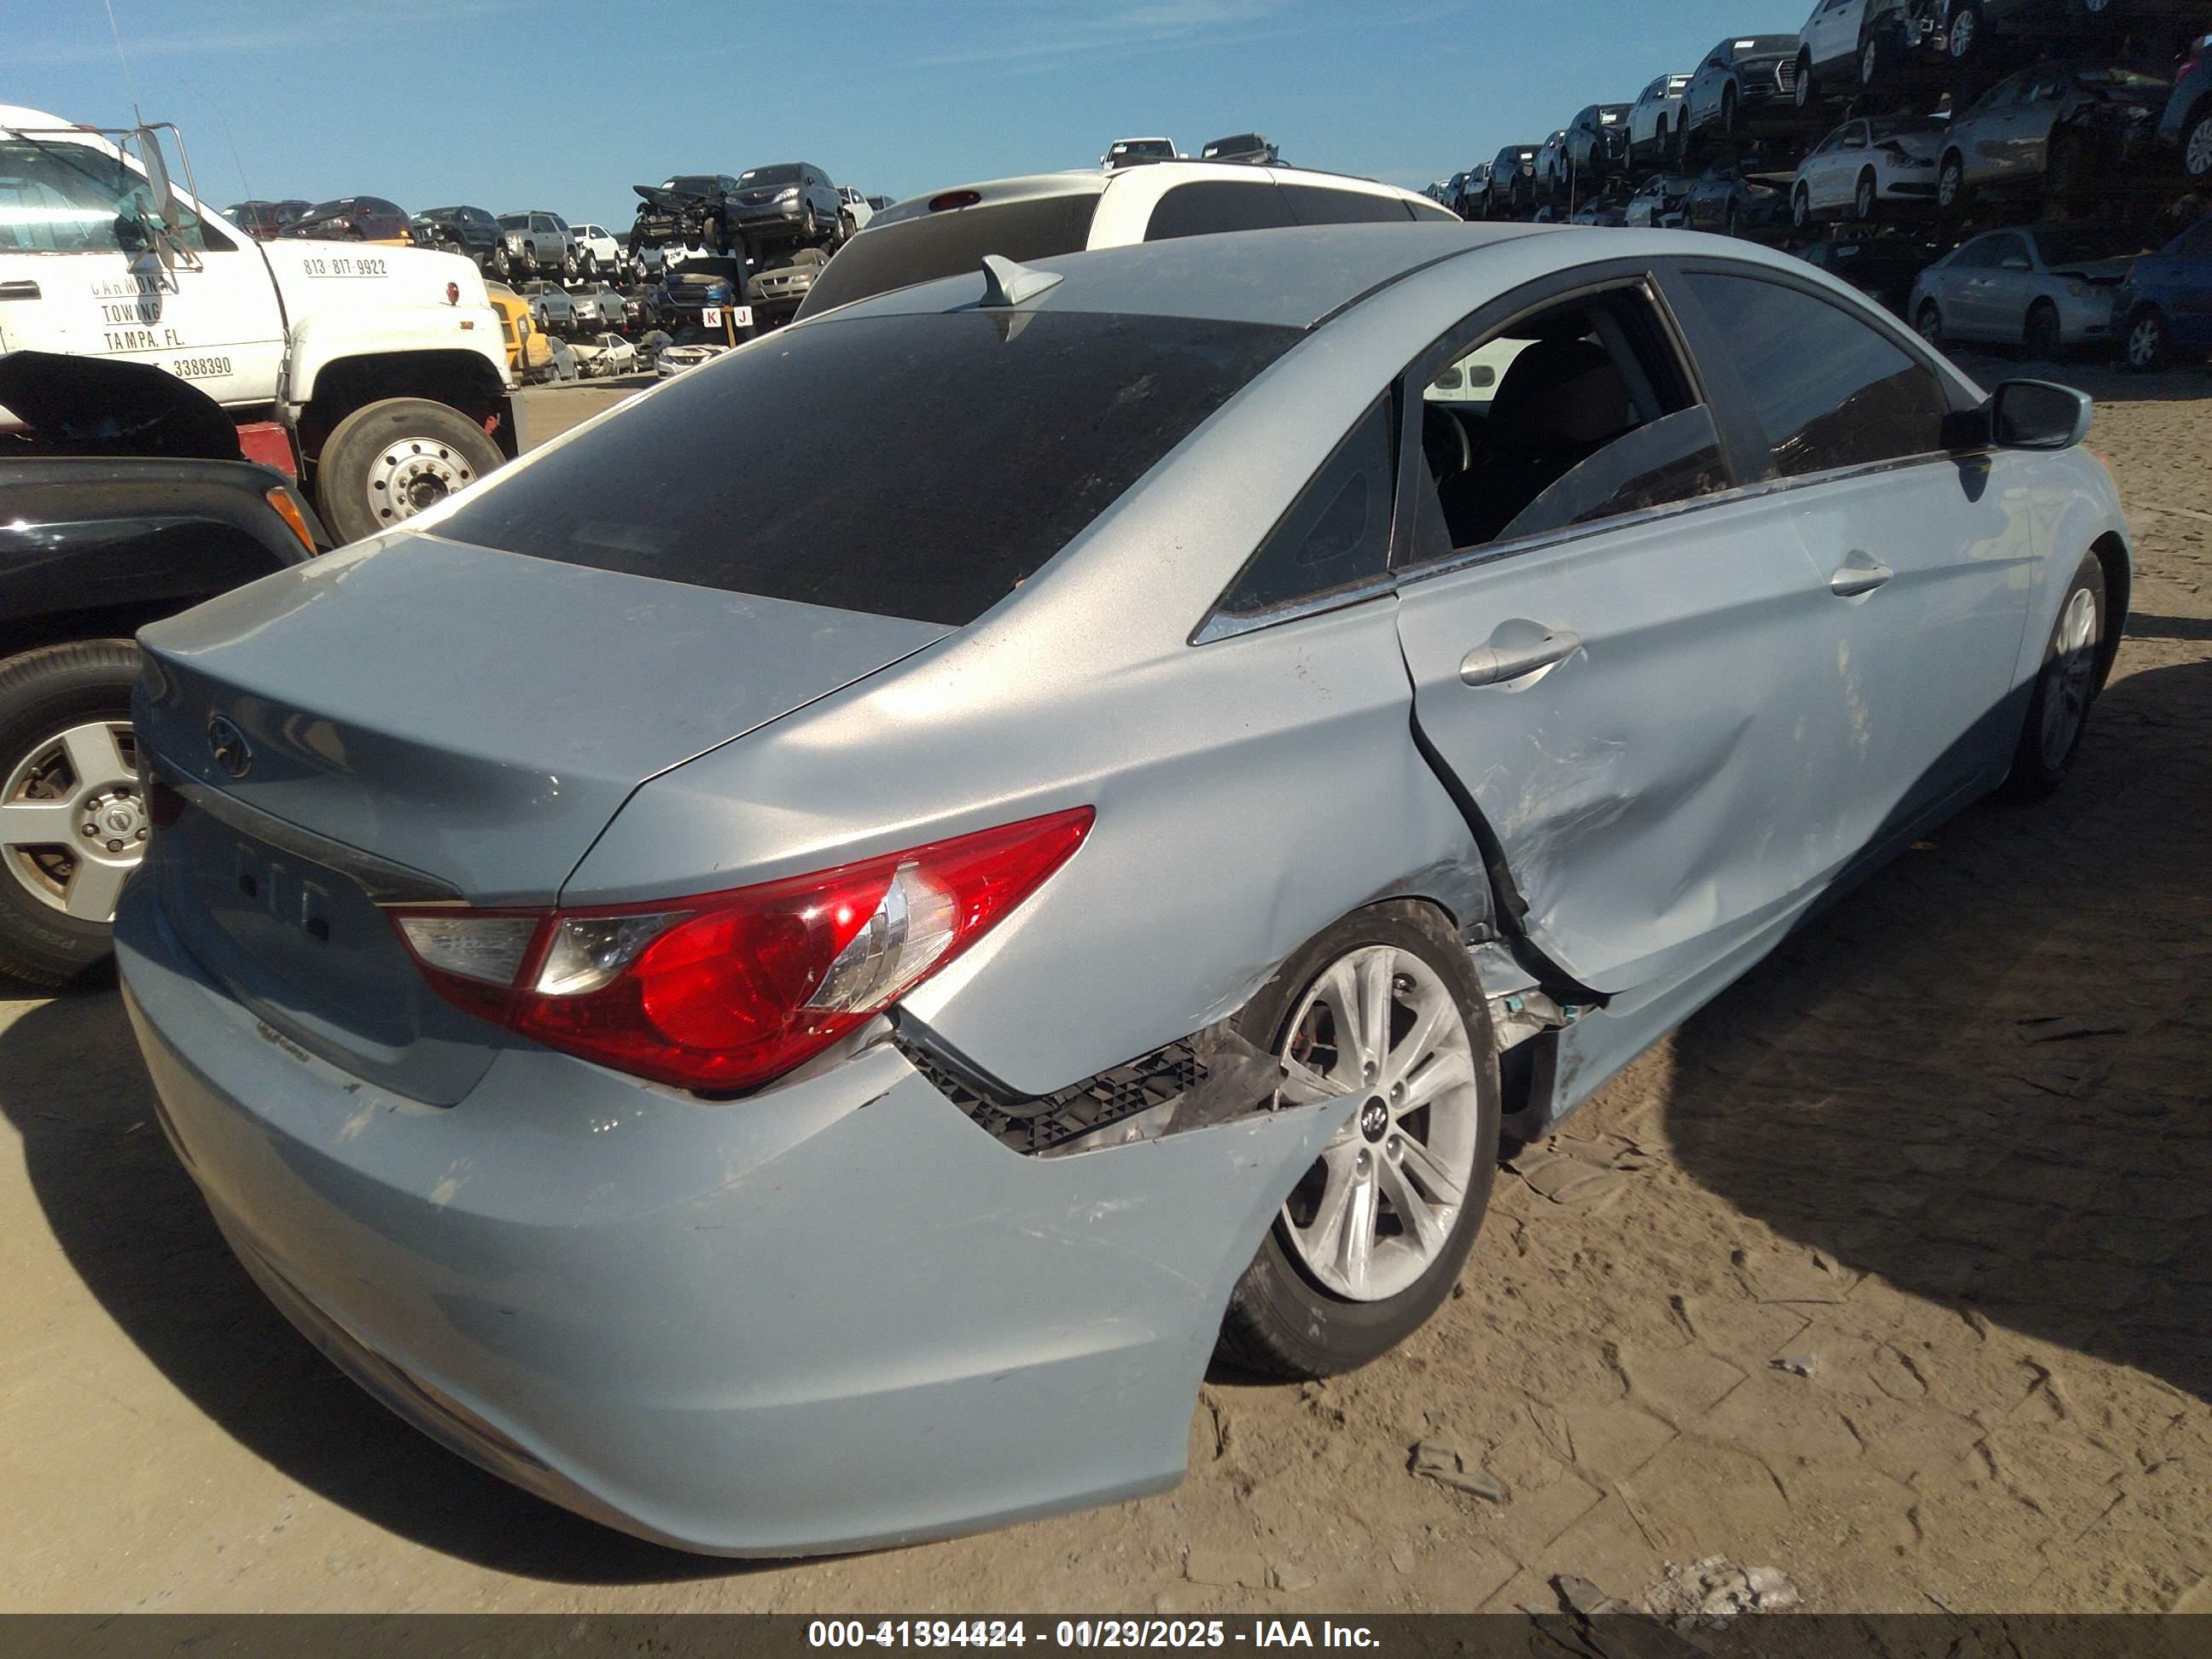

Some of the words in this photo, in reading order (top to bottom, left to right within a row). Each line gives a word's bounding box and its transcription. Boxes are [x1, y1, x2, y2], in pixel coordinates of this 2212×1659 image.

[102, 302, 160, 323] TOWING
[707, 311, 718, 324] K
[738, 310, 747, 323] J
[104, 330, 160, 351] TAMPA,
[165, 329, 185, 346] FL.
[173, 357, 231, 377] 3388390
